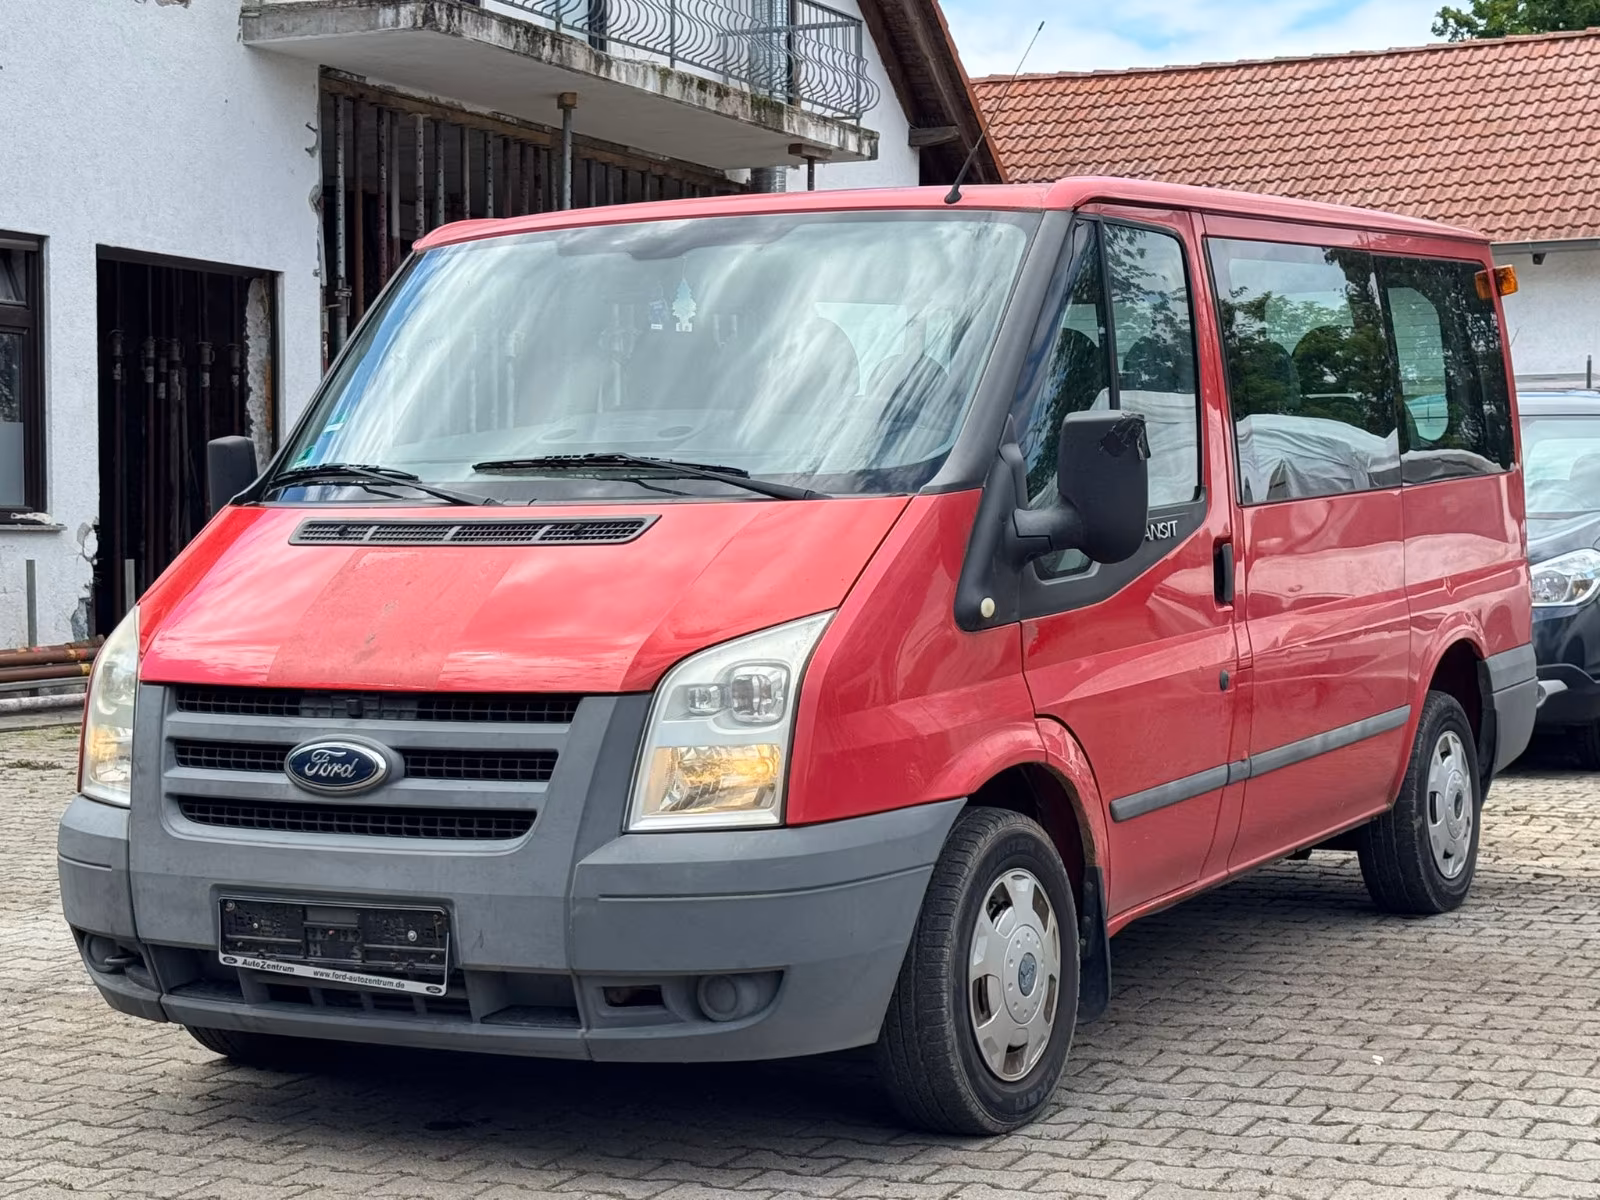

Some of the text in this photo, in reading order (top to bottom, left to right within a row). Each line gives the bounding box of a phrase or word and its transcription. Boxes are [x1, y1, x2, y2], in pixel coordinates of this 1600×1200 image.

[304, 749, 359, 778] Ford
[241, 958, 295, 973] AutoZentrum
[313, 970, 405, 989] www.ford-autozentrum.de
